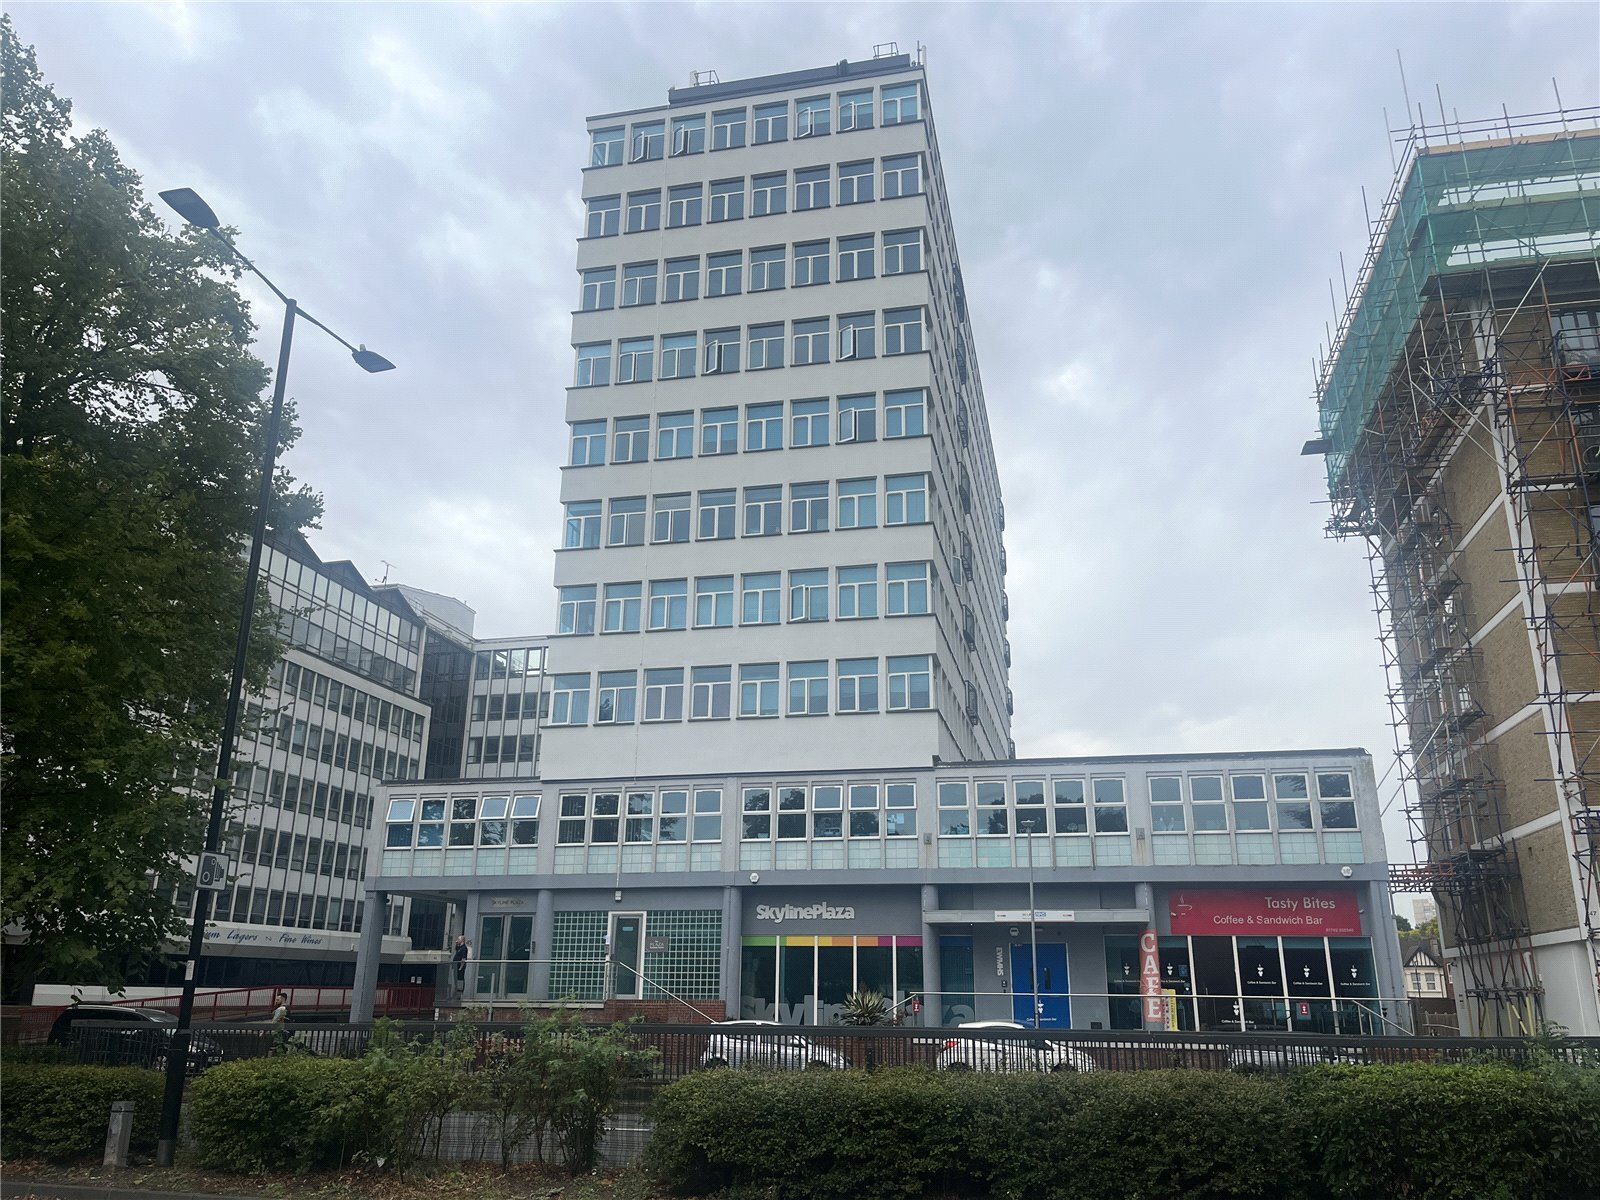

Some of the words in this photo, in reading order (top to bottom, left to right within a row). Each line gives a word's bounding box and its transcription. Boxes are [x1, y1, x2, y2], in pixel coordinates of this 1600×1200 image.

[1264, 896, 1299, 911] Tasty
[1303, 896, 1336, 909] Bites
[756, 901, 855, 924] SkylinePlaza
[1213, 915, 1244, 925] Coffee
[1246, 915, 1254, 925] &
[1256, 915, 1303, 925] Sandwich
[1305, 916, 1323, 925] Bar
[227, 929, 258, 944] Lagers
[1141, 933, 1162, 1018] CAFE
